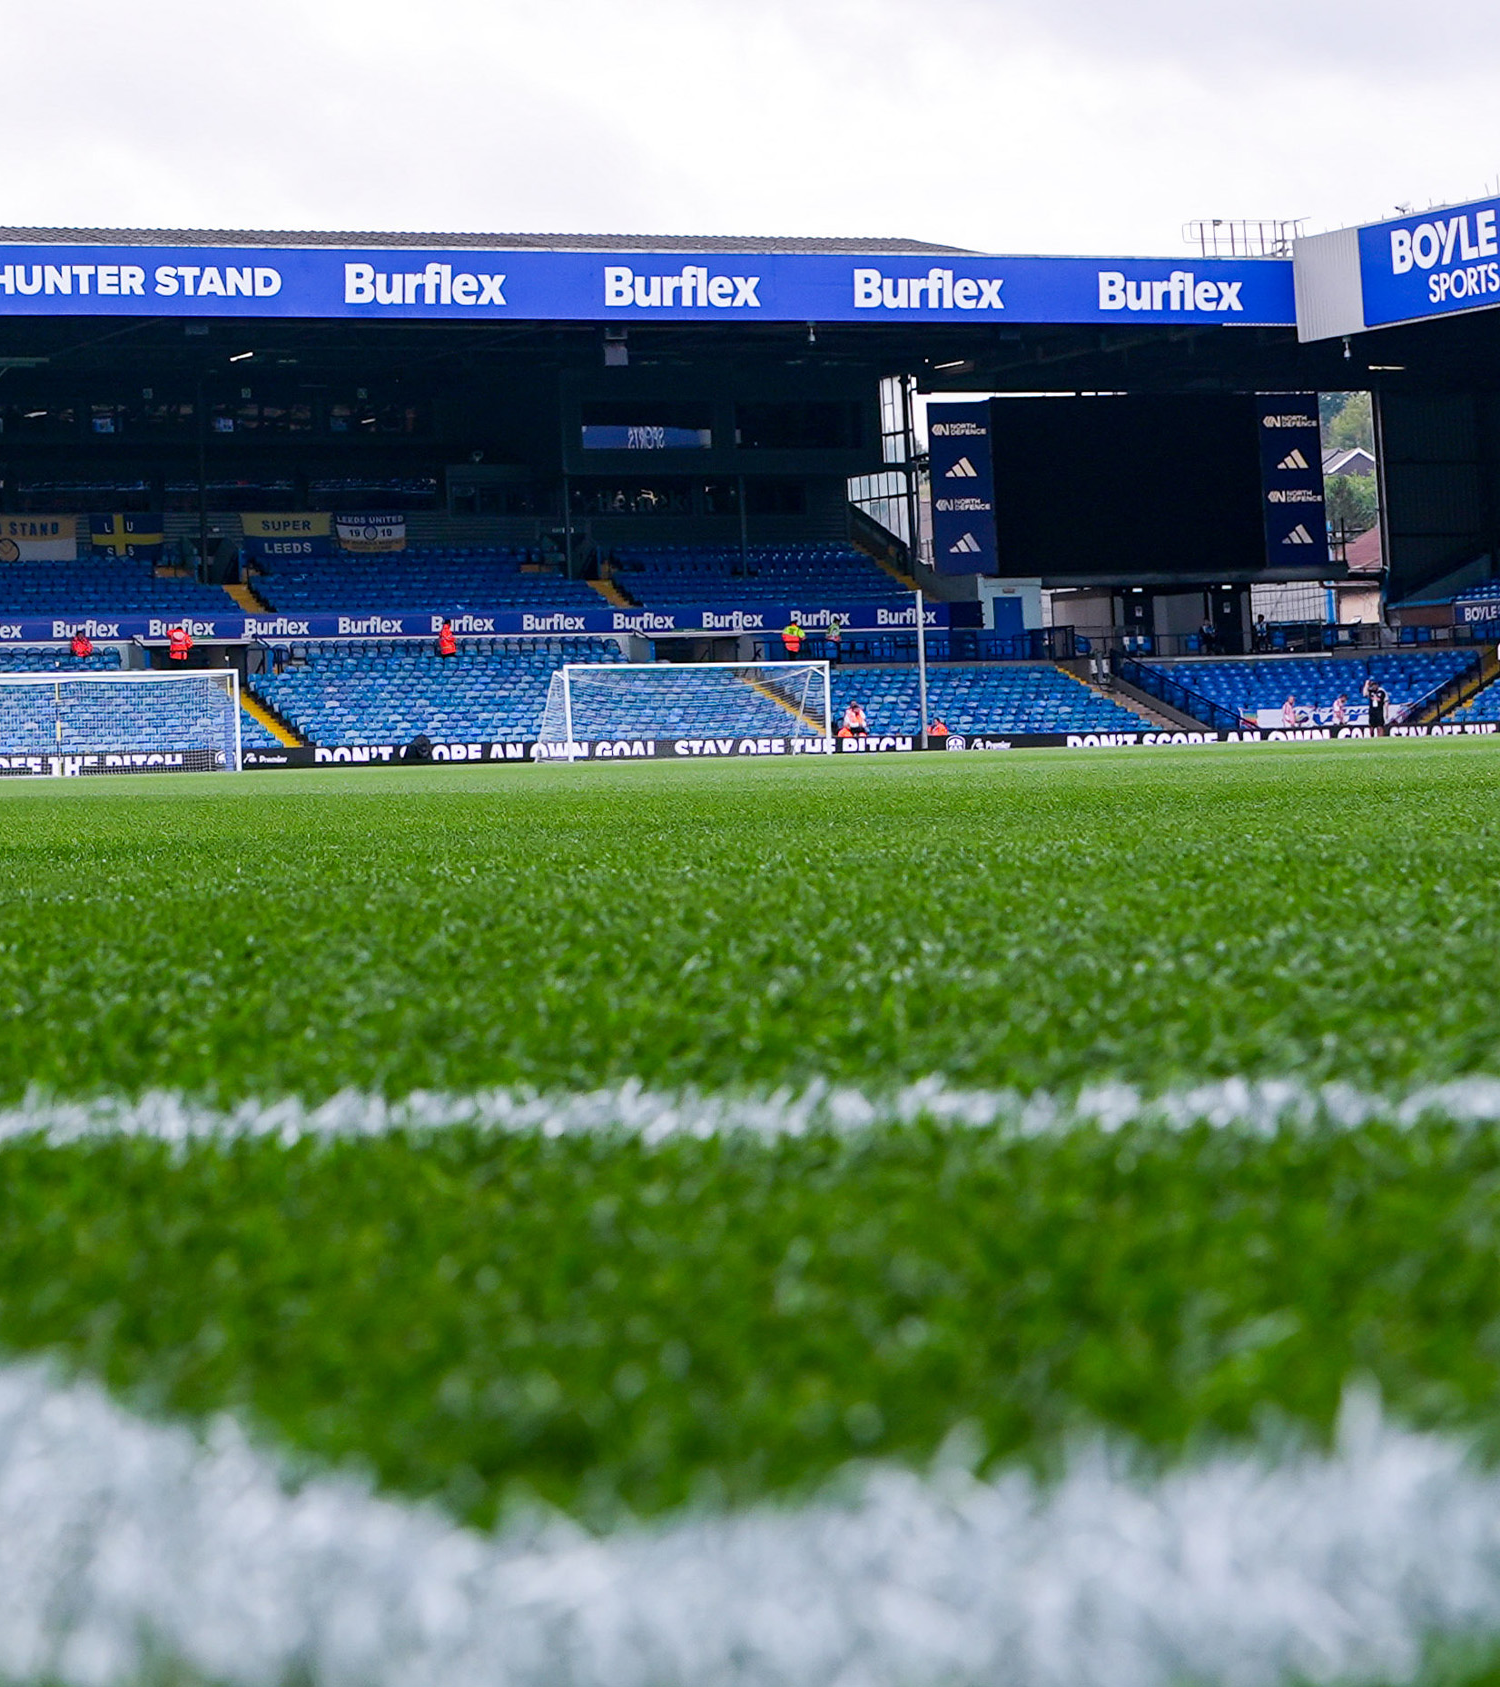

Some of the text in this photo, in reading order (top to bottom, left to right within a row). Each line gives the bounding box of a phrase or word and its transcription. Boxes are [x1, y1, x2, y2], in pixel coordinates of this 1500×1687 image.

[1390, 208, 1499, 275] BOYLE
[155, 266, 281, 296] STAND
[345, 263, 506, 305] Burflex
[605, 266, 760, 307] Burflex
[854, 268, 1004, 309] Burflex
[1428, 261, 1500, 304] SPORTS
[1098, 271, 1243, 311] Burflex
[950, 428, 986, 436] DEFENCE
[1281, 420, 1318, 428] DEFENCE
[954, 503, 991, 511] DEFENCE
[1287, 495, 1322, 503] DEFENCE
[261, 520, 312, 531] SUPER
[336, 514, 404, 524] LEEDS UNITED
[9, 521, 60, 536] STAND
[350, 529, 361, 537] 19
[263, 542, 313, 554] LEEDS
[523, 614, 584, 630] Burflex
[614, 613, 674, 631] Burflex
[703, 611, 762, 629] Burflex
[878, 608, 935, 625] Burflx
[1464, 605, 1497, 622] BOYLE
[243, 618, 308, 636] Burflex
[339, 616, 402, 633] Burflex
[399, 744, 483, 761] ORE
